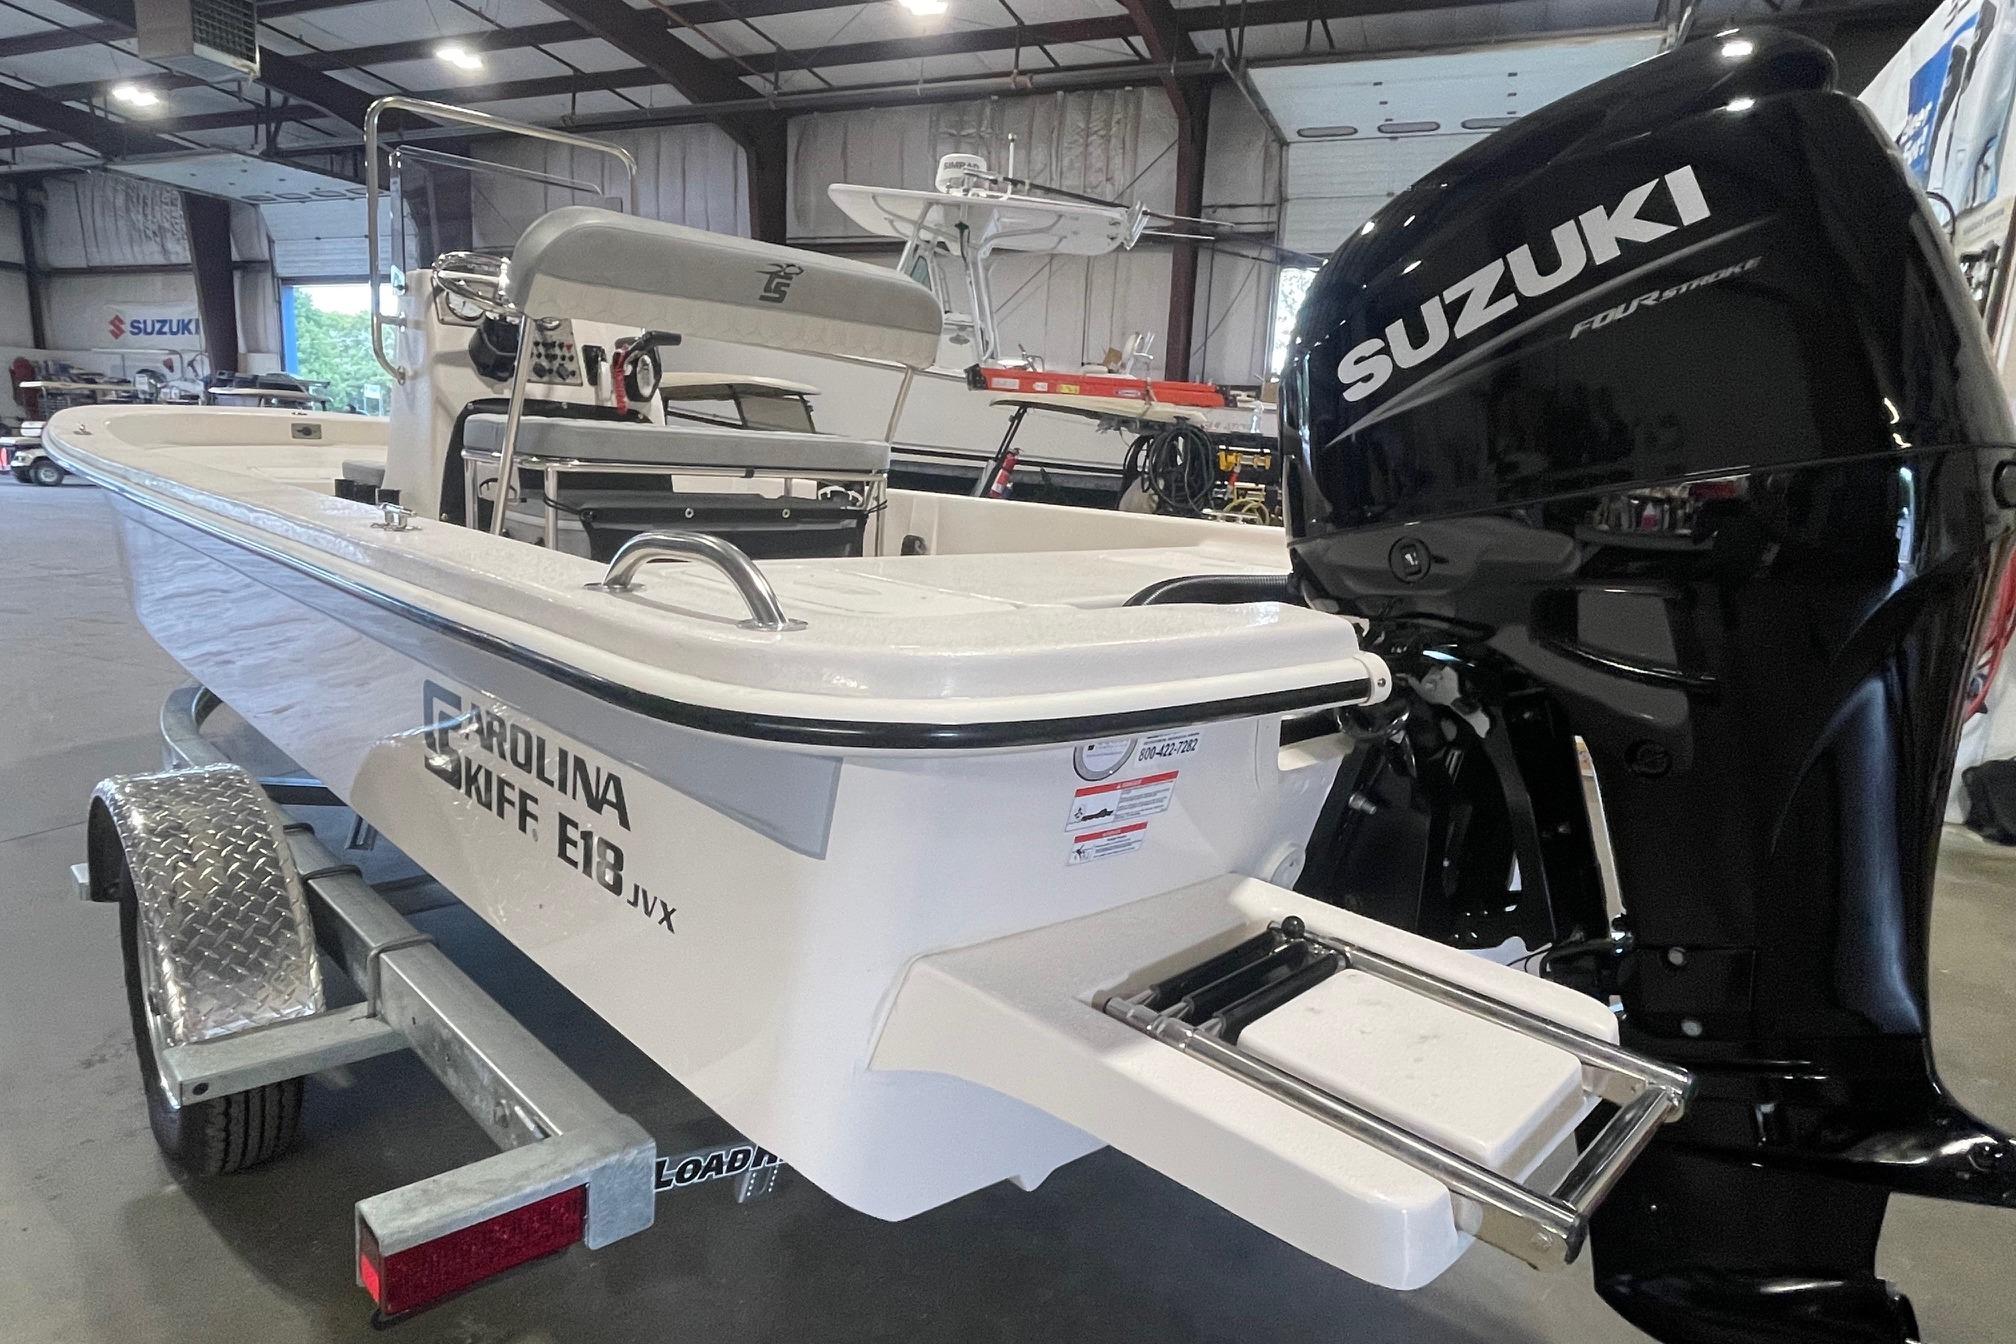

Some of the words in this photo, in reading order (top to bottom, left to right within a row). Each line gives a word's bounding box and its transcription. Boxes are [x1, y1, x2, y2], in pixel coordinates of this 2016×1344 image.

[129, 318, 200, 336] SUZUKI
[1337, 164, 1711, 402] SUZUKI
[423, 679, 631, 832] CAROLINA
[1138, 738, 1199, 761] 800-422-7282
[557, 811, 624, 897] E18
[626, 883, 677, 934] JVX
